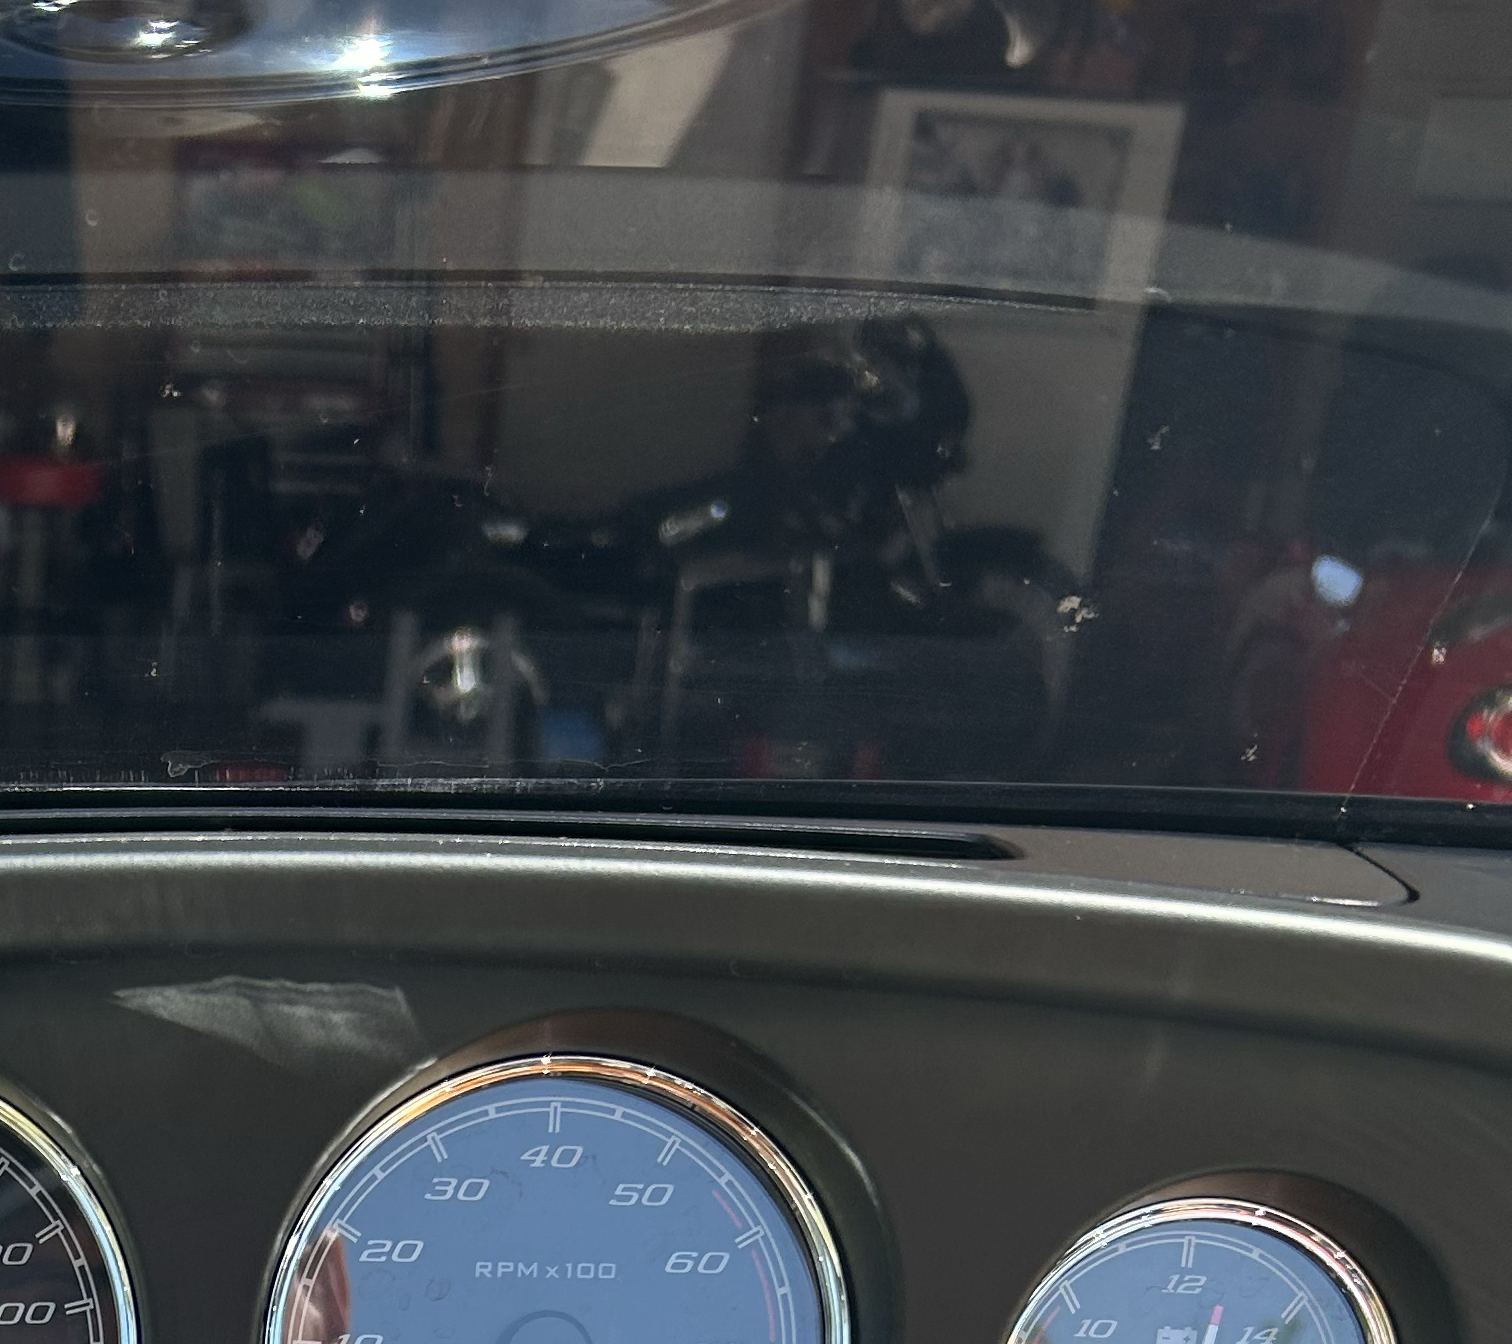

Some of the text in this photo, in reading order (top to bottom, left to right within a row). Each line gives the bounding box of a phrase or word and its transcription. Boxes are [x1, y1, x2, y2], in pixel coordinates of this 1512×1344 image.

[520, 1145, 584, 1168] 40
[423, 1178, 490, 1201] 30
[608, 1183, 675, 1207] 50
[358, 1240, 424, 1263] 20
[664, 1251, 730, 1275] 60
[1161, 1274, 1207, 1295] 12
[1073, 1319, 1118, 1339] 10
